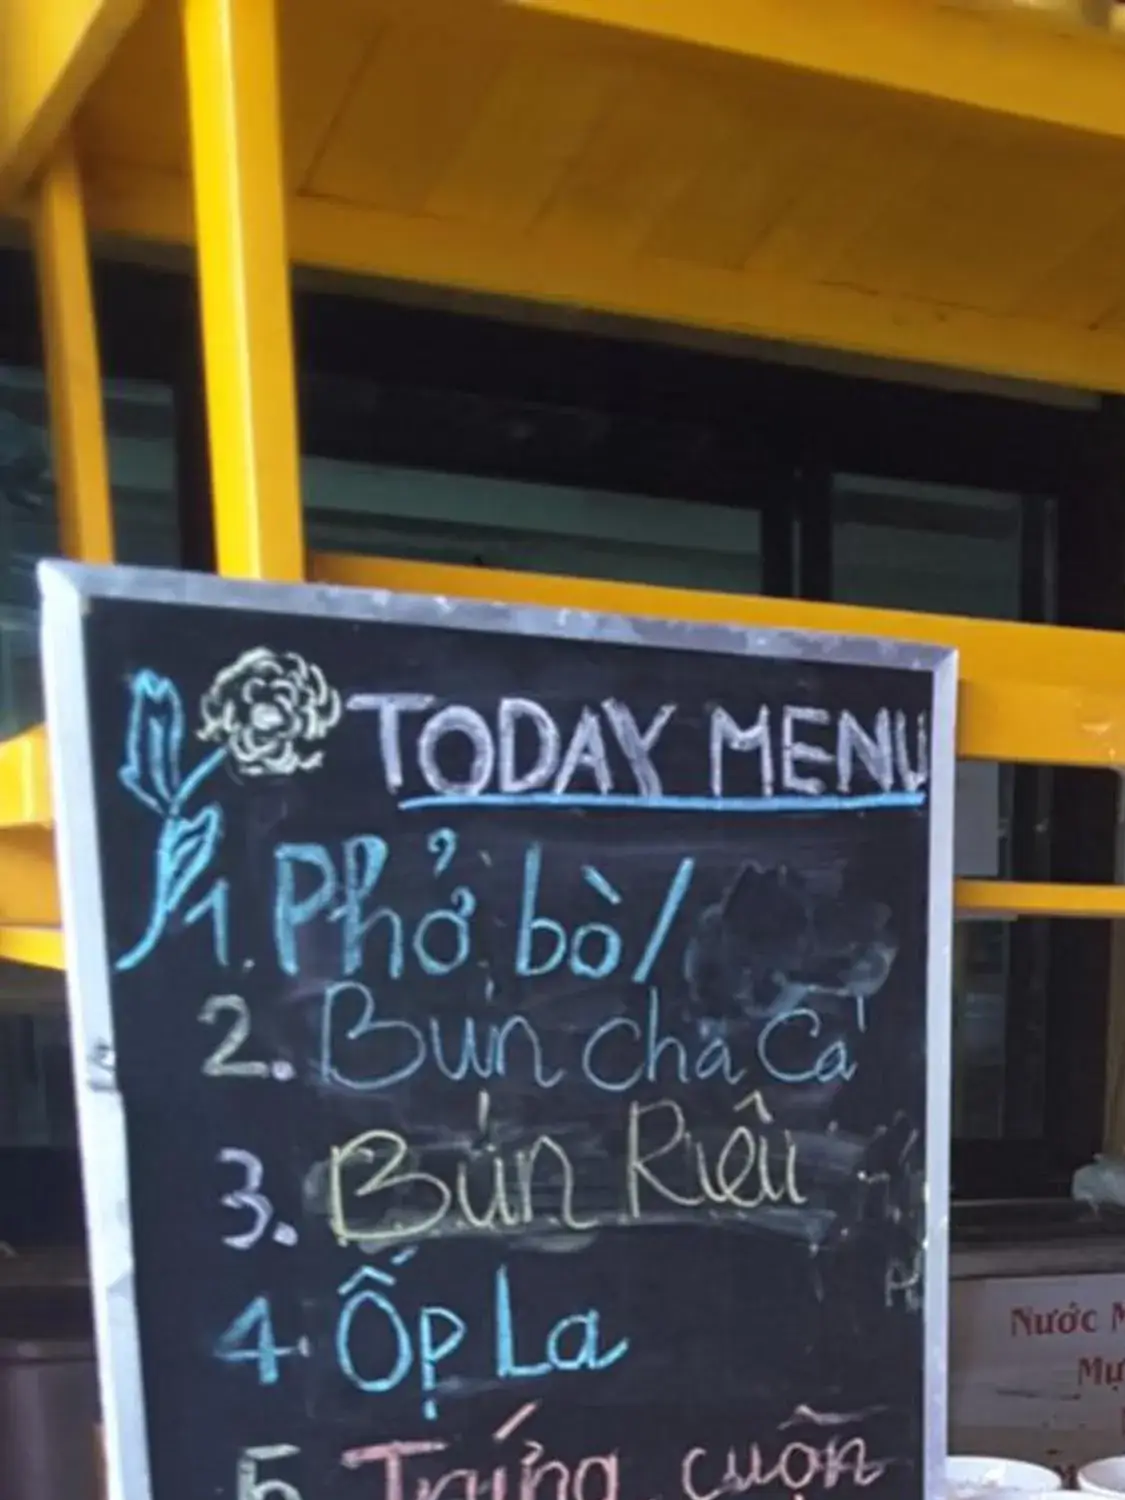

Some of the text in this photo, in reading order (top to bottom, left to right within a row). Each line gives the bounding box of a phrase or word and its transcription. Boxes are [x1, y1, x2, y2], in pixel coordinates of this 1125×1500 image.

[347, 693, 928, 798] TODAY MENU
[274, 828, 475, 980] Phở
[198, 993, 295, 1081] 2.
[219, 1147, 299, 1250] 3.
[329, 1089, 597, 1247] Bún
[494, 1263, 630, 1380] La
[1010, 1301, 1098, 1337] Nước
